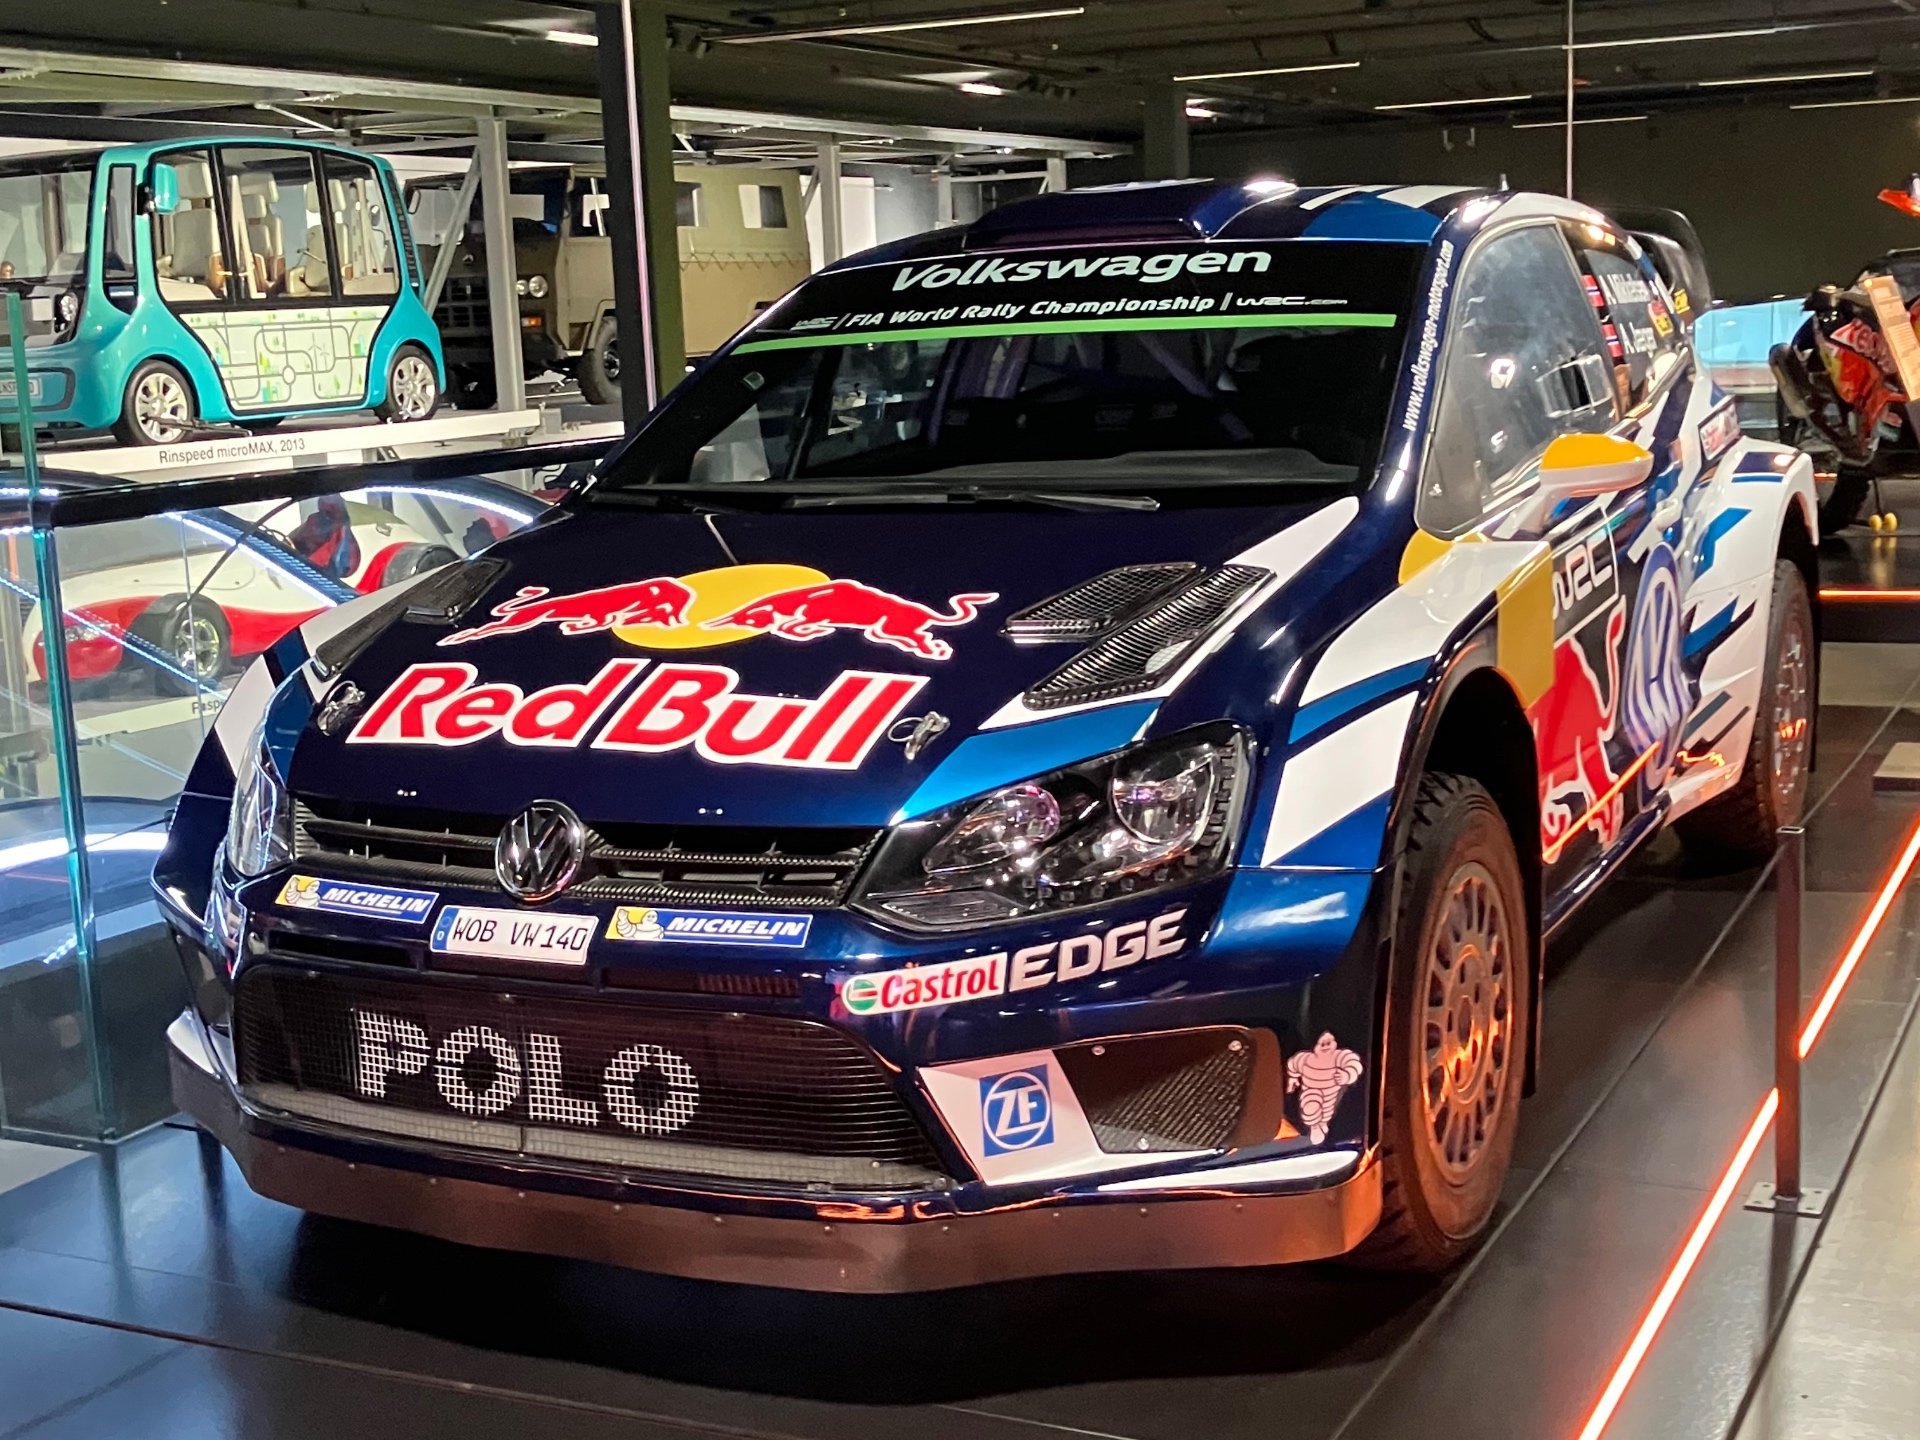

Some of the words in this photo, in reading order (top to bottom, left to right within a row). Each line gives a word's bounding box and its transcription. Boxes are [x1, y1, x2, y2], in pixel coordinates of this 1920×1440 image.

[891, 250, 1272, 292] Volkswagen
[846, 313, 885, 328] FIA
[890, 306, 959, 324] World
[961, 303, 1025, 320] Rally
[1029, 295, 1216, 316] Championship
[1402, 239, 1454, 432] www.volkswagen-motorsport.com
[159, 446, 214, 464] Rinspeed
[217, 440, 278, 459] microMAX,
[280, 438, 306, 452] 2013
[348, 658, 650, 747] Red
[591, 662, 930, 770] Bull
[321, 886, 430, 914] MICHELIN
[452, 916, 498, 943] WOB
[667, 915, 805, 937] MICHELIN
[881, 959, 1000, 1009] Castrol
[1008, 908, 1188, 993] EDGE
[358, 1010, 700, 1135] POLO
[985, 1082, 1049, 1138] ZF
